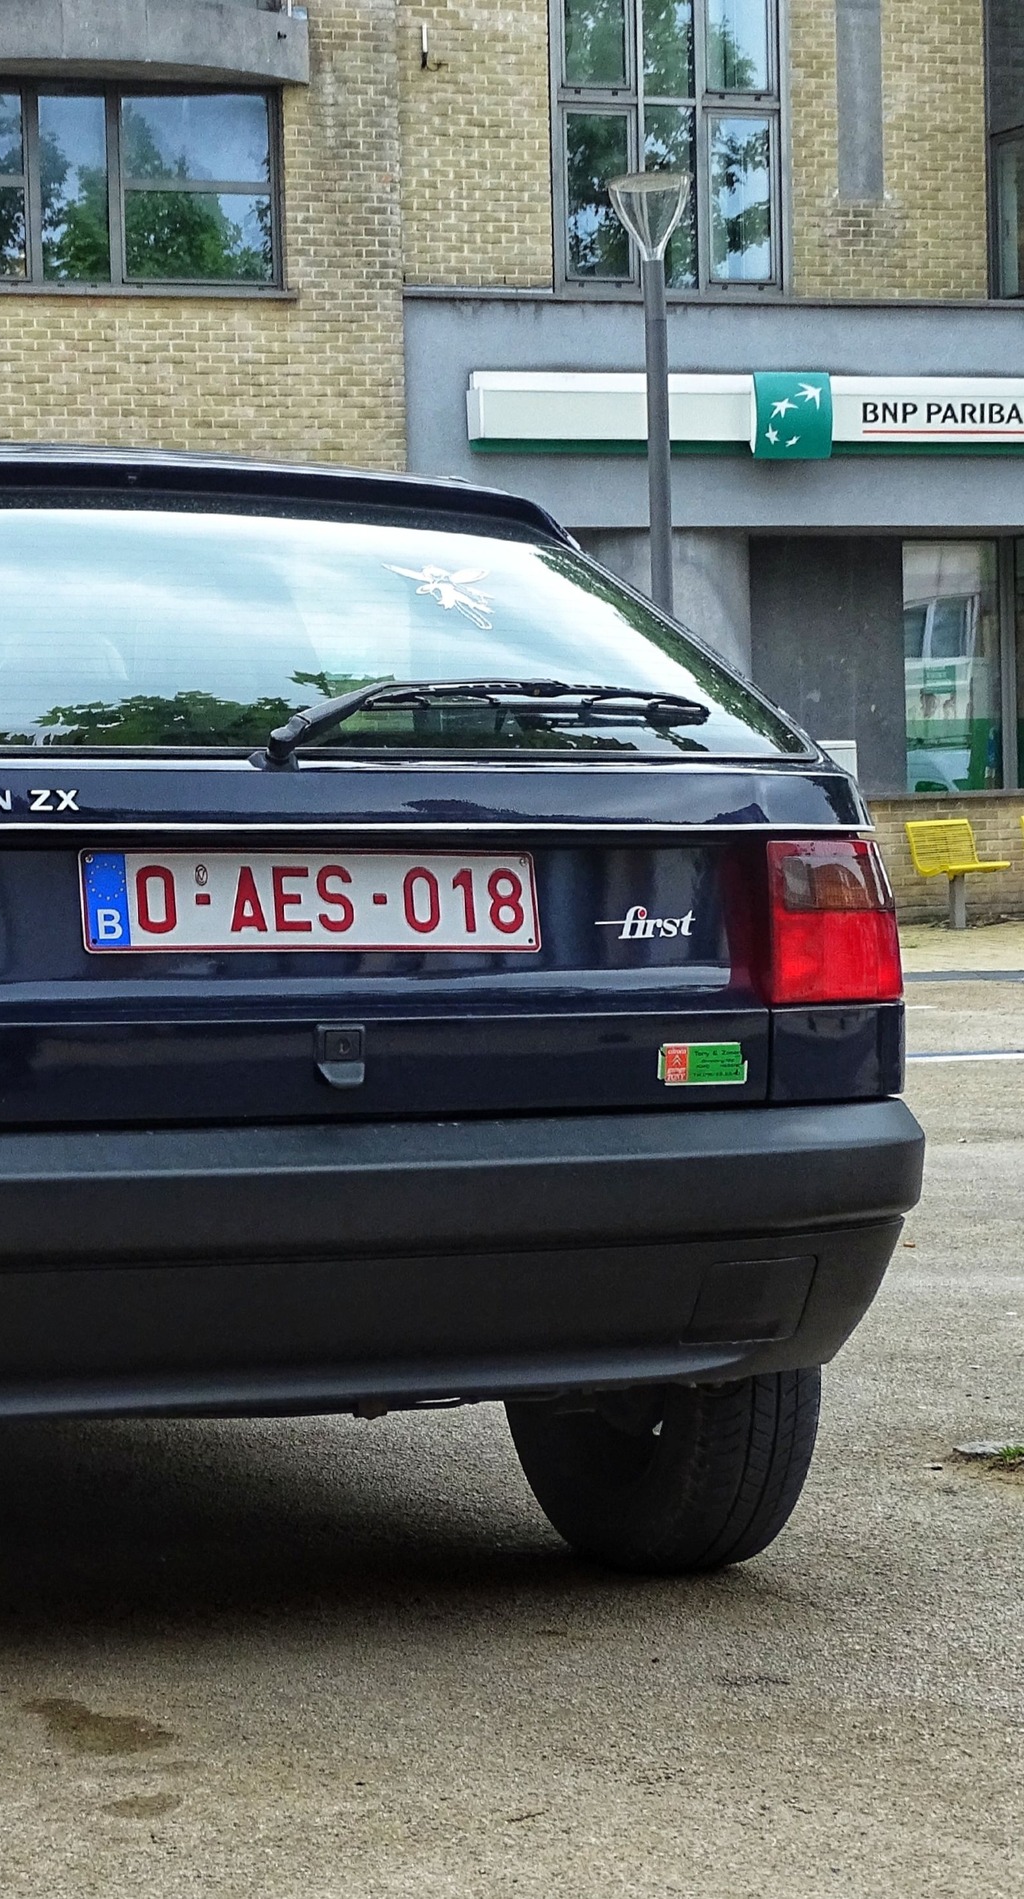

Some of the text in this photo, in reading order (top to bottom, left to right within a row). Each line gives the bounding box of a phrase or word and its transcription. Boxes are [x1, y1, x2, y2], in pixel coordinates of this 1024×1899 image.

[862, 402, 1024, 425] BNP PARIBA
[29, 789, 80, 811] ZX
[97, 908, 123, 940] B
[595, 905, 696, 939] first
